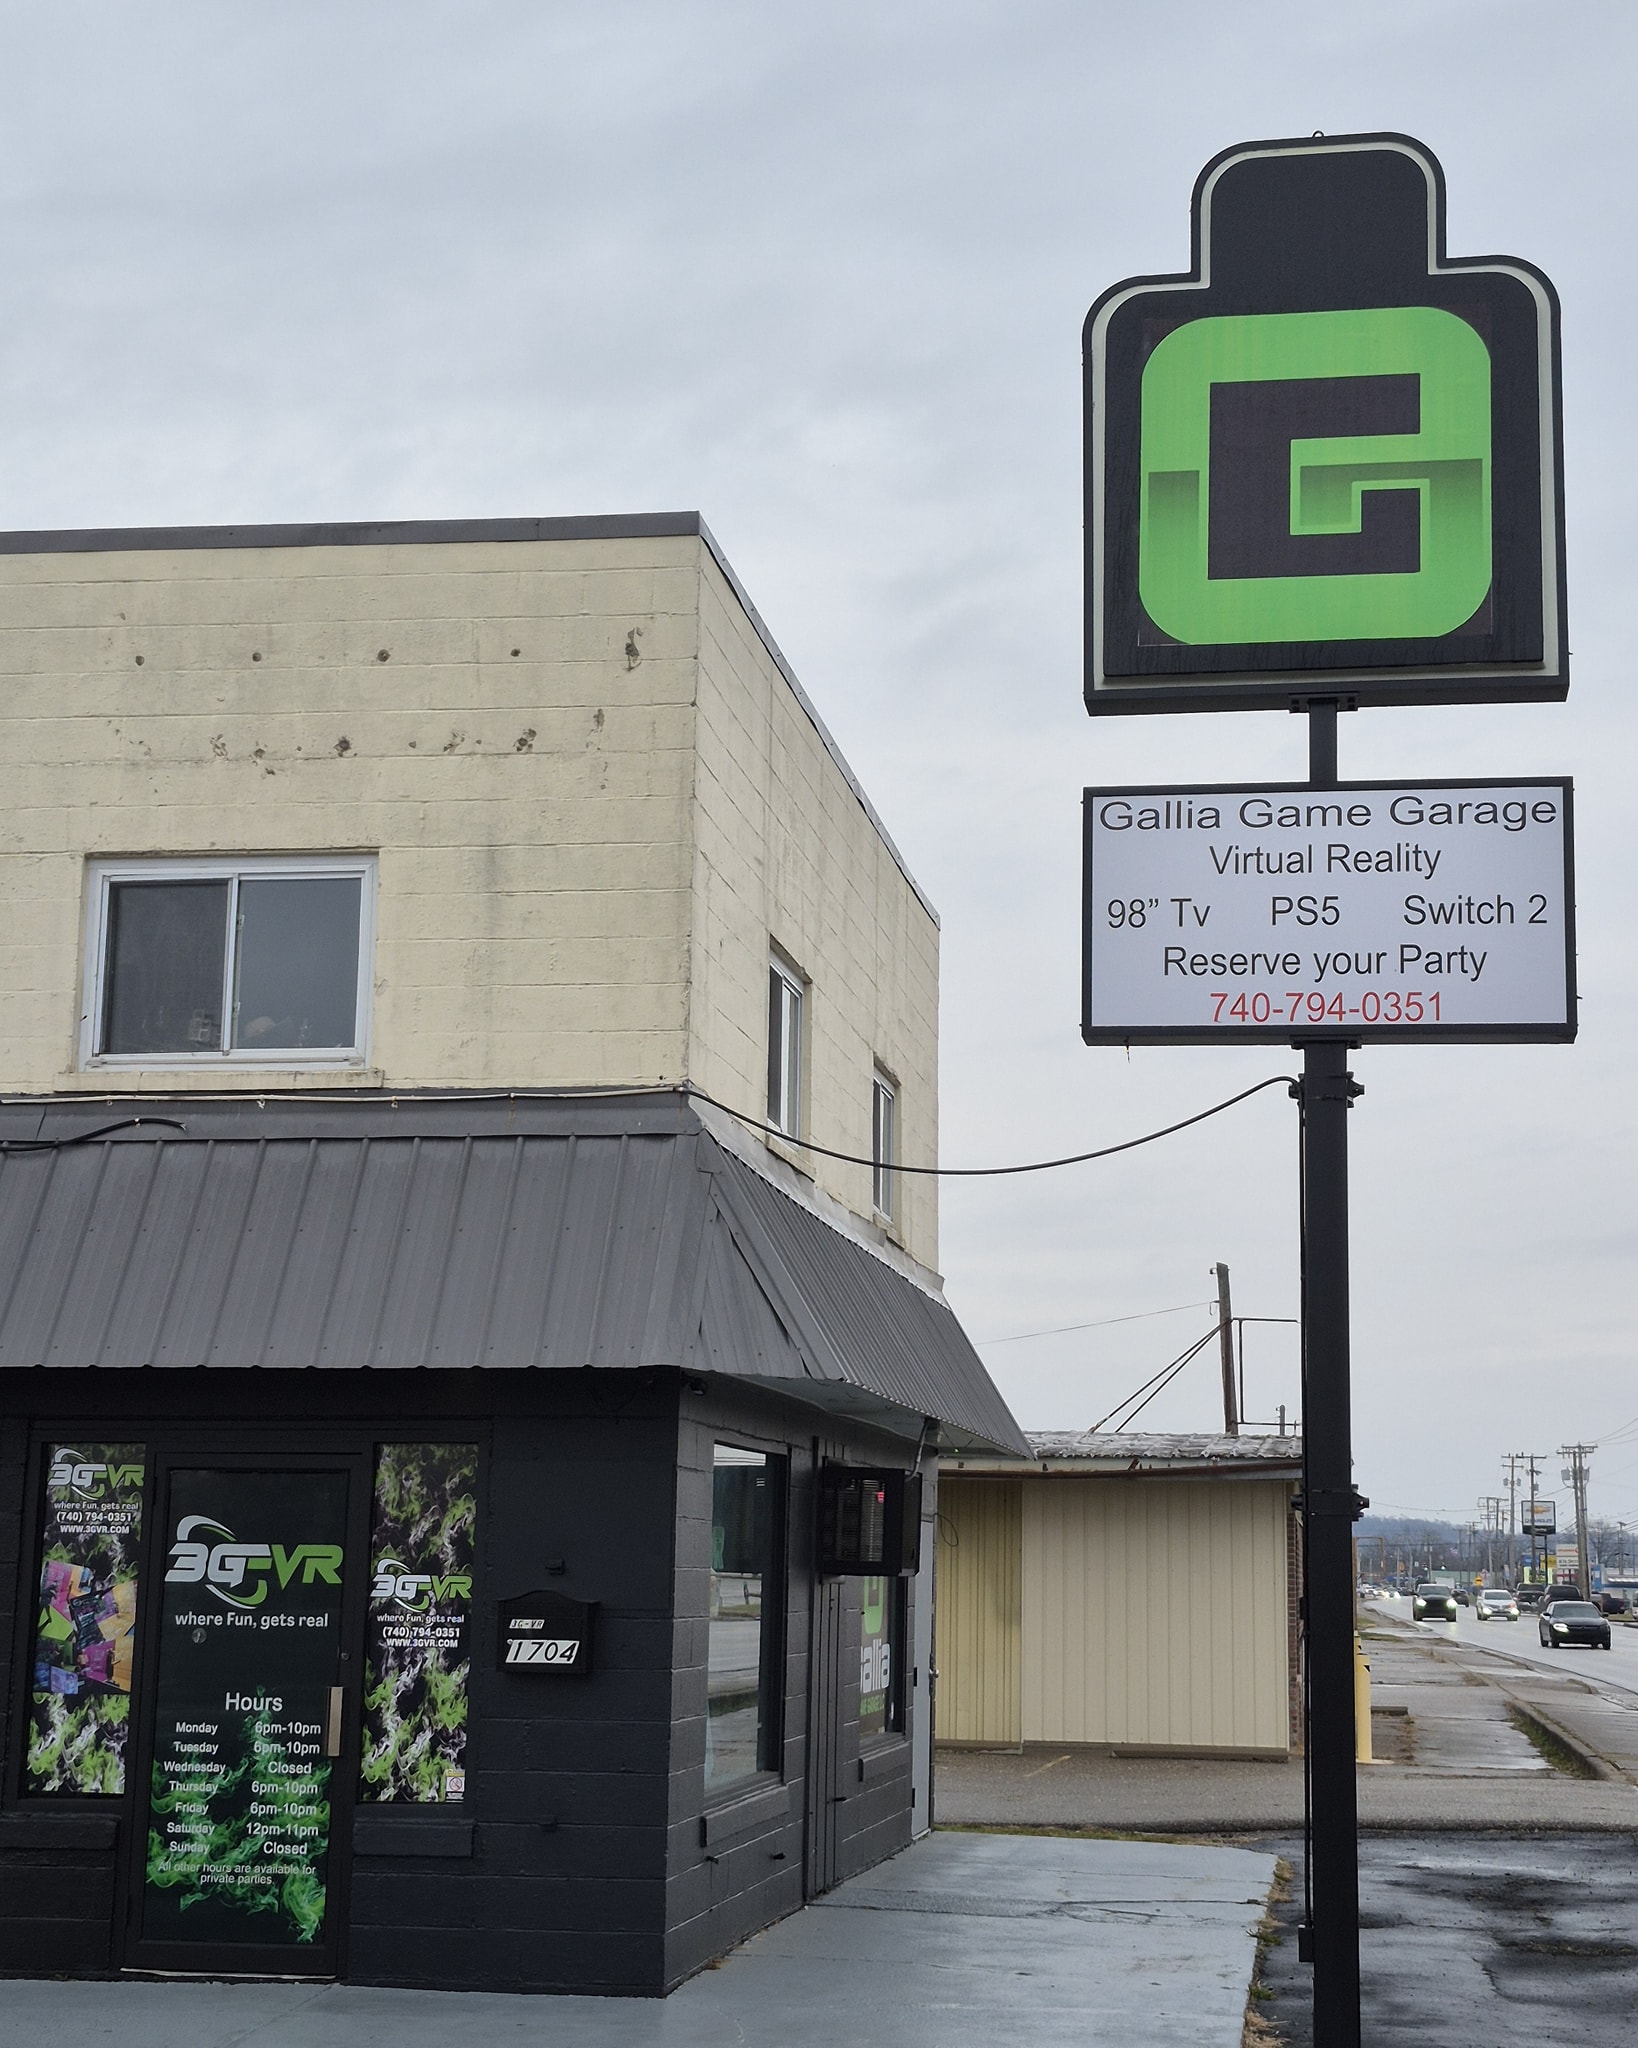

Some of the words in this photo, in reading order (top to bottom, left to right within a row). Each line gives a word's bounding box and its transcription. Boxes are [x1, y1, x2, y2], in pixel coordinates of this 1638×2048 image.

[1099, 799, 1222, 832] Gallia
[1239, 798, 1372, 828] Game
[1389, 795, 1558, 832] Garage
[1209, 843, 1313, 875] Virtual
[1327, 841, 1442, 880] Reality
[1171, 898, 1211, 928] Tv
[1271, 895, 1340, 927] PS5
[1403, 894, 1515, 926] Switch
[1528, 894, 1548, 925] 2
[1163, 946, 1301, 977] Reserve
[1313, 951, 1387, 983] your
[1399, 943, 1488, 982] Party
[1210, 990, 1442, 1023] 740-794-0351
[53, 1501, 80, 1510] where
[101, 1502, 120, 1511] gets
[121, 1502, 139, 1510] real
[56, 1511, 83, 1522] (740)
[85, 1512, 132, 1522] 794-0351
[175, 1611, 223, 1626] where
[226, 1612, 257, 1629] Fun,
[260, 1613, 295, 1630] gets
[298, 1612, 329, 1627] real
[376, 1613, 404, 1622] where
[425, 1614, 446, 1623] gets
[447, 1614, 465, 1623] real
[382, 1626, 410, 1638] (740)
[412, 1627, 460, 1637] 794-0351
[386, 1638, 459, 1648] WWW.3GVR.COM
[513, 1641, 577, 1662] 1704
[860, 1638, 891, 1694] allia
[225, 1691, 283, 1712] Hours
[175, 1721, 219, 1736] Monday
[255, 1720, 321, 1737] 6pm-10pm
[173, 1741, 219, 1755] Tuesday
[254, 1740, 320, 1757] 6pm-10pm
[163, 1760, 226, 1775] Wednesday
[268, 1760, 312, 1774] Closed
[168, 1780, 219, 1795] Thursday
[251, 1780, 318, 1797] 6pm-10pm
[175, 1801, 209, 1815] Friday
[250, 1801, 317, 1818] 6pm-10pm
[166, 1822, 216, 1836] Saturday
[246, 1822, 319, 1839] 12pm-11pm
[169, 1841, 210, 1855] Sunday
[263, 1841, 308, 1855] Closed
[158, 1861, 171, 1872] All
[173, 1862, 200, 1873] other
[203, 1863, 232, 1873] hours
[234, 1864, 251, 1873] are
[254, 1864, 300, 1875] available
[302, 1864, 316, 1875] for
[200, 1873, 235, 1885] private
